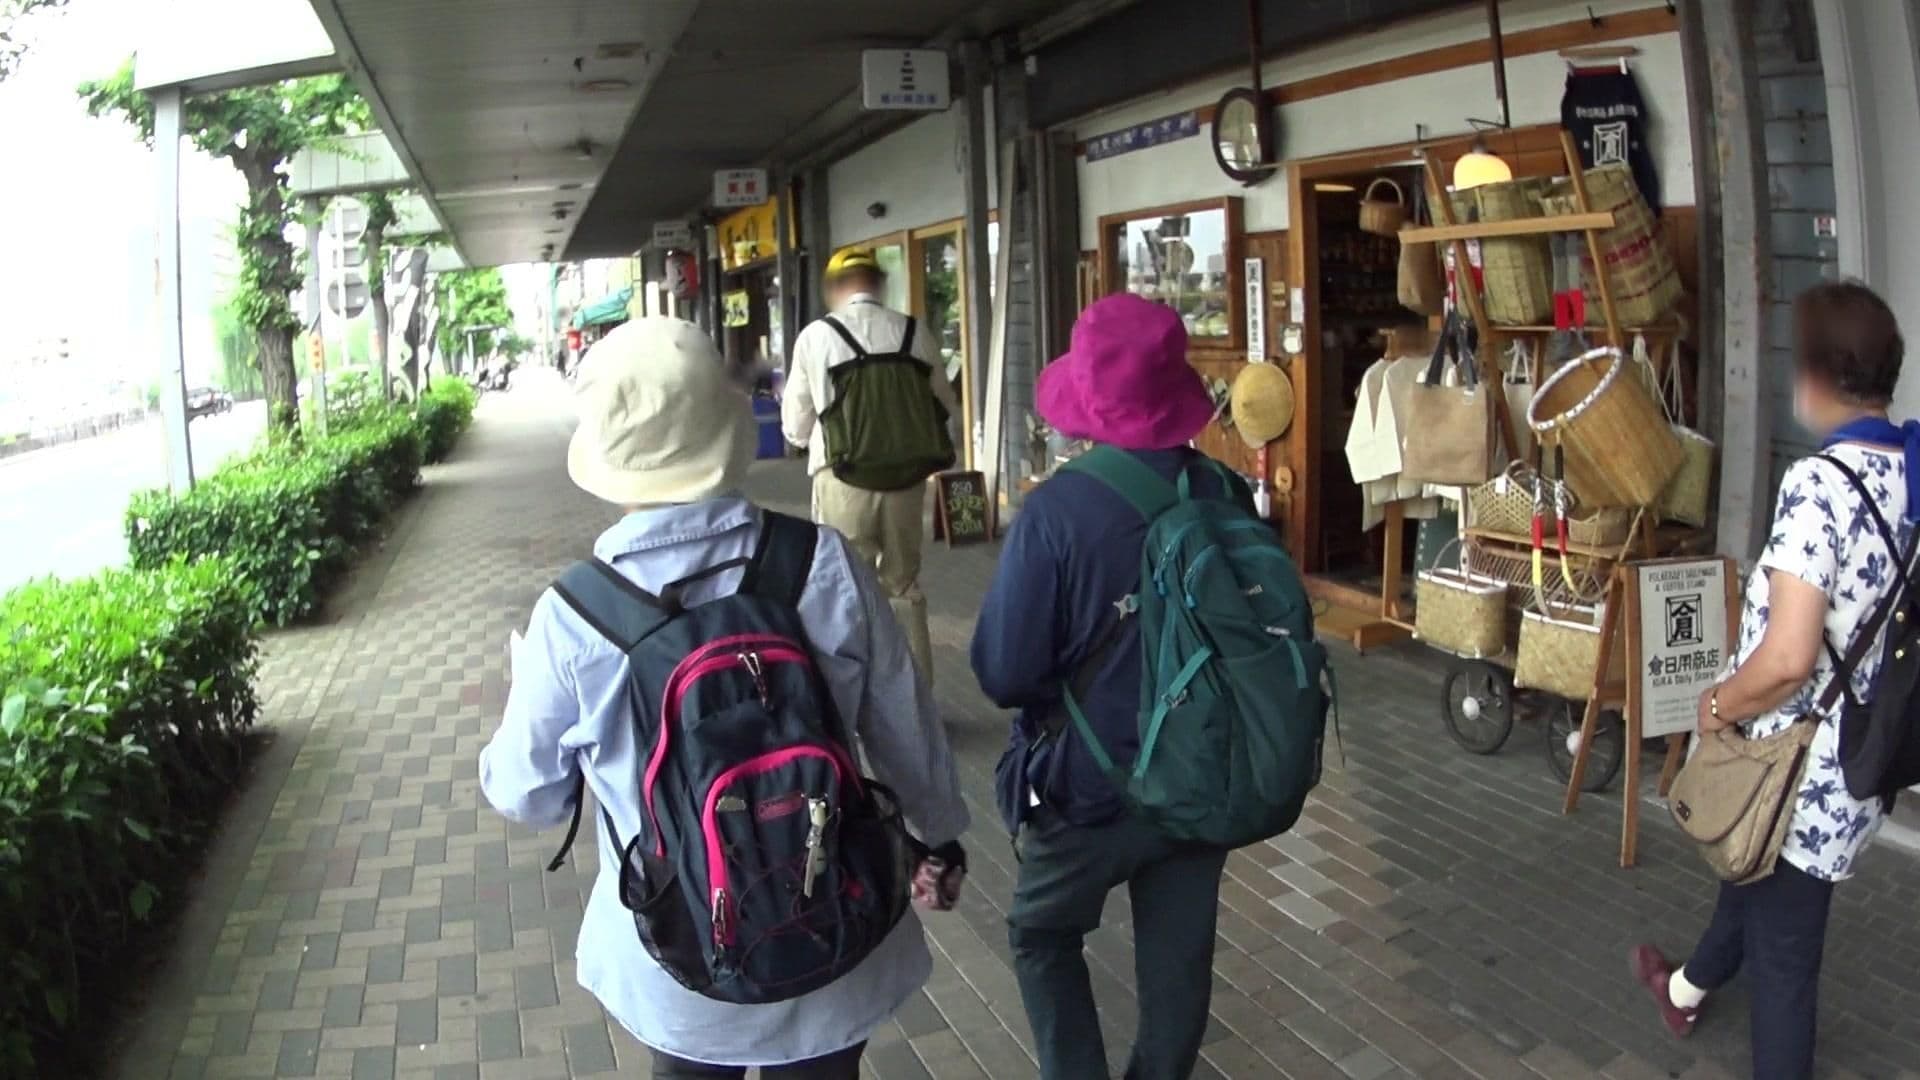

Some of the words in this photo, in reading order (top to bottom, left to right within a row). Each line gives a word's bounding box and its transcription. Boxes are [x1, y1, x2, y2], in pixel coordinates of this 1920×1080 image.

[1648, 648, 1719, 676] 倉日用商店
